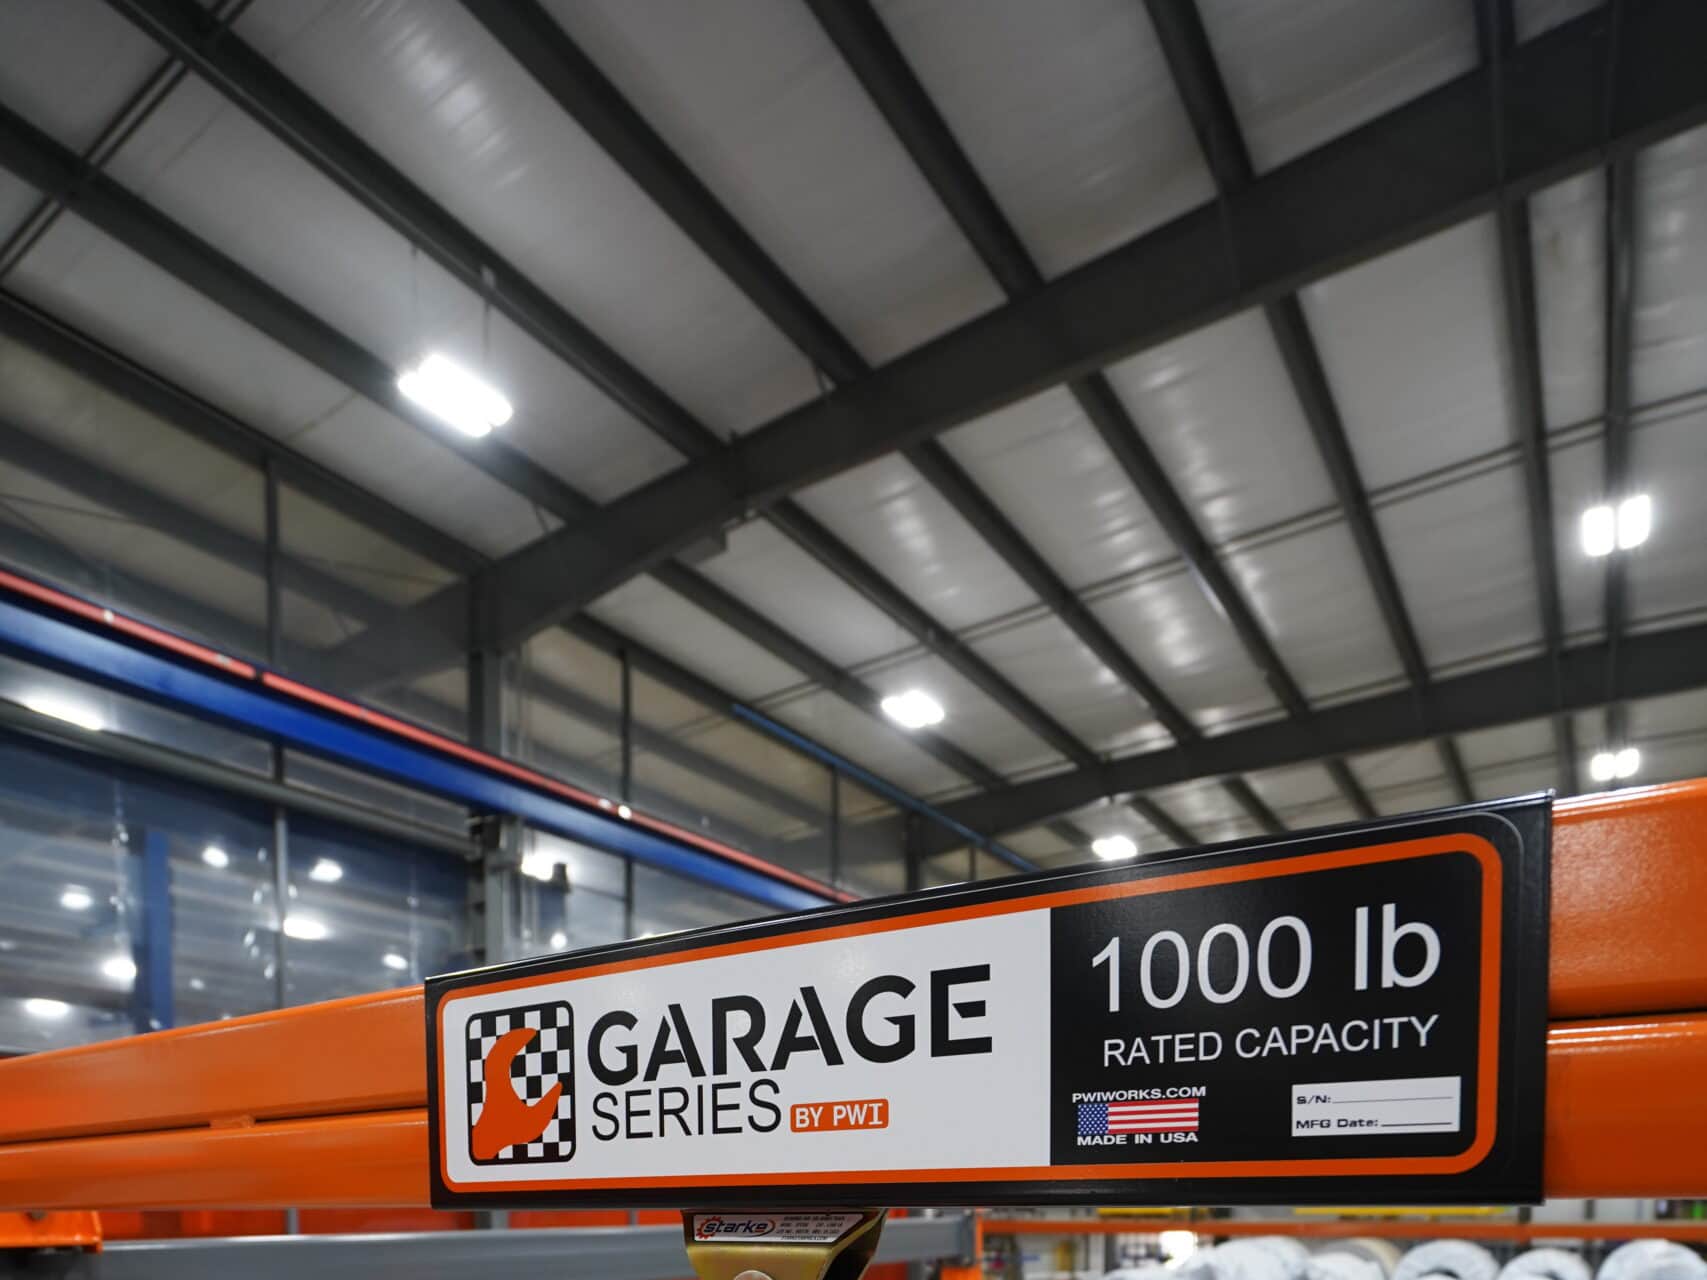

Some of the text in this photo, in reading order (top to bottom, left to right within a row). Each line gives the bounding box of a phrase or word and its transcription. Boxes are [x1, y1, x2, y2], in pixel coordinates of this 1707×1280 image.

[1091, 903, 1441, 1013] 1000 lb
[587, 963, 992, 1087] GARAGE
[1103, 1014, 1439, 1067] RATED CAPACITY
[1071, 1086, 1207, 1103] PWIWORKS.COM
[1296, 1095, 1331, 1105] S/N:
[591, 1078, 782, 1142] SERIES
[795, 1103, 883, 1128] BY PWI
[1296, 1118, 1378, 1129] MFG Date:
[1077, 1132, 1199, 1146] MADE IN USA
